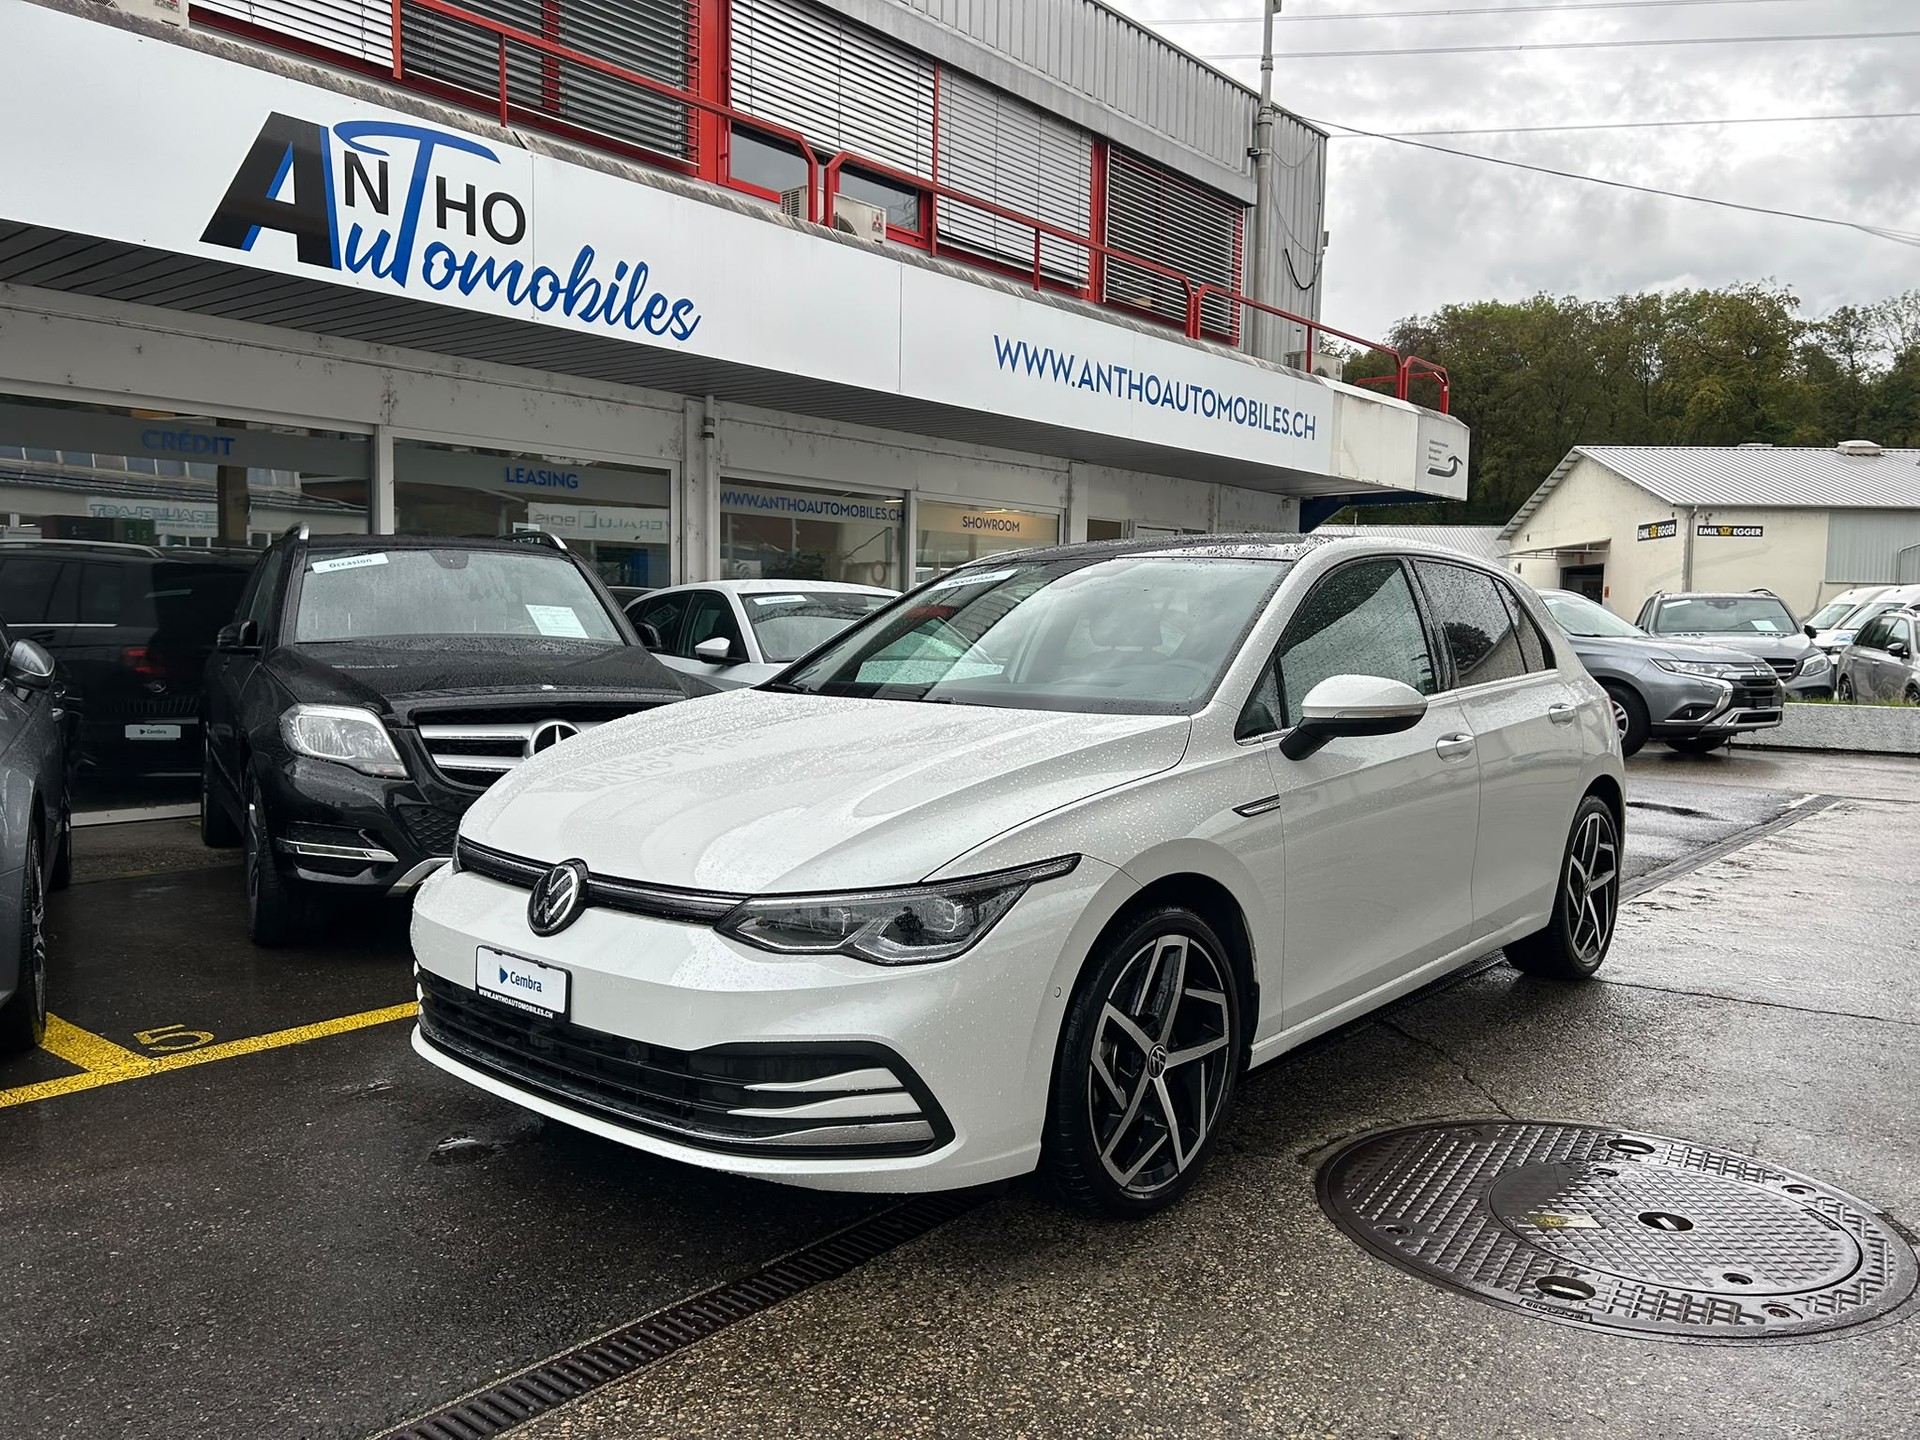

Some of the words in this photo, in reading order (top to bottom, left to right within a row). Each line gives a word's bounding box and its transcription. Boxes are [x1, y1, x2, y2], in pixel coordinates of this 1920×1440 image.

[200, 111, 526, 287] ANTHO
[993, 334, 1316, 440] WWW.ANTHOAUTOMOBILES.CH
[143, 429, 235, 456] CRÉDIT
[505, 466, 578, 489] LEASING
[720, 491, 905, 522] WWW.ANTHOAUTOMOBILES.CH
[962, 515, 1020, 532] SHOWROOM
[1638, 527, 1650, 539] EMIL
[1658, 524, 1676, 536] EGGER
[1699, 527, 1719, 535] EMIL
[1733, 528, 1762, 536] EGGER
[329, 558, 372, 568] Occasion
[510, 971, 542, 993] Cembra
[479, 988, 554, 1019] WWW.ANTHOAUTOMOBILES.CH
[133, 1023, 215, 1051] 5
